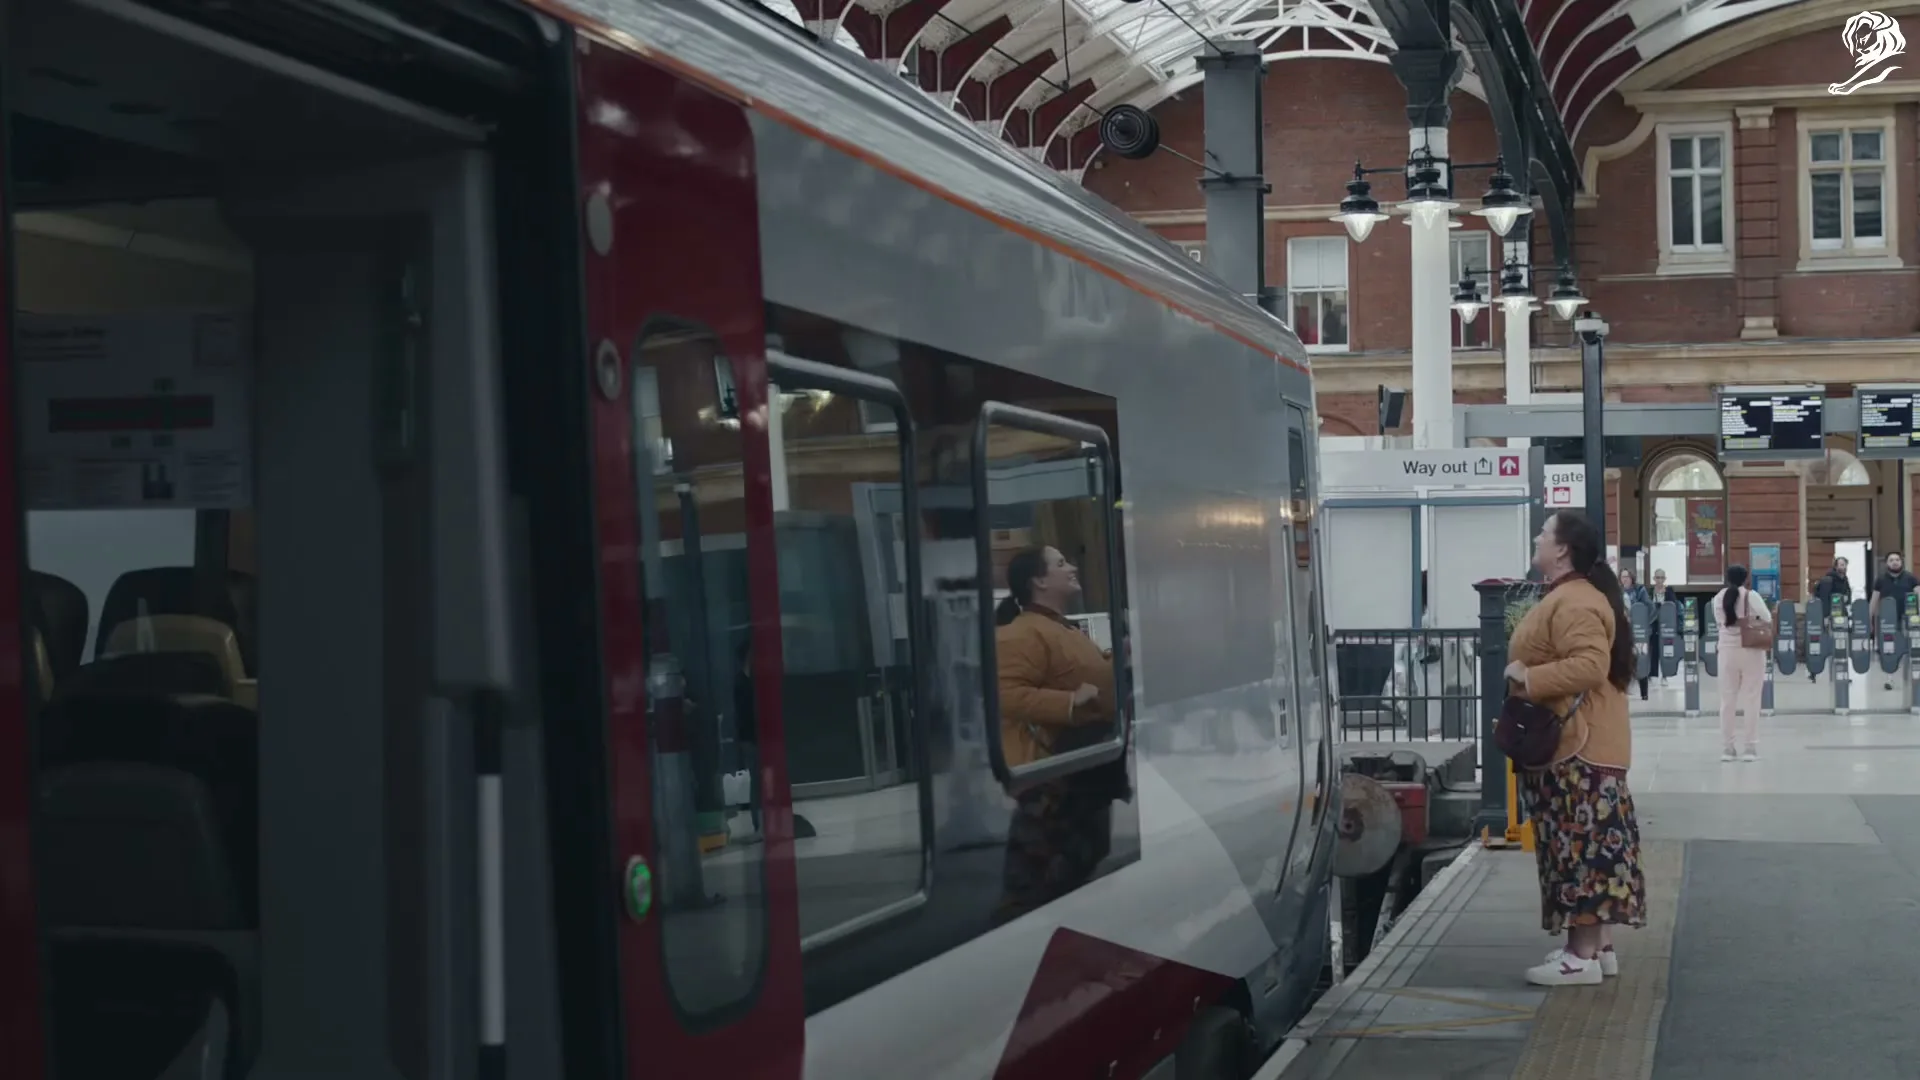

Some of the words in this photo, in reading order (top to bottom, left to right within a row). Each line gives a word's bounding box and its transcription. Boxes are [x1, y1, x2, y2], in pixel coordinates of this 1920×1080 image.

[1403, 460, 1437, 477] Way
[1441, 460, 1468, 474] out
[1552, 472, 1584, 485] gate
